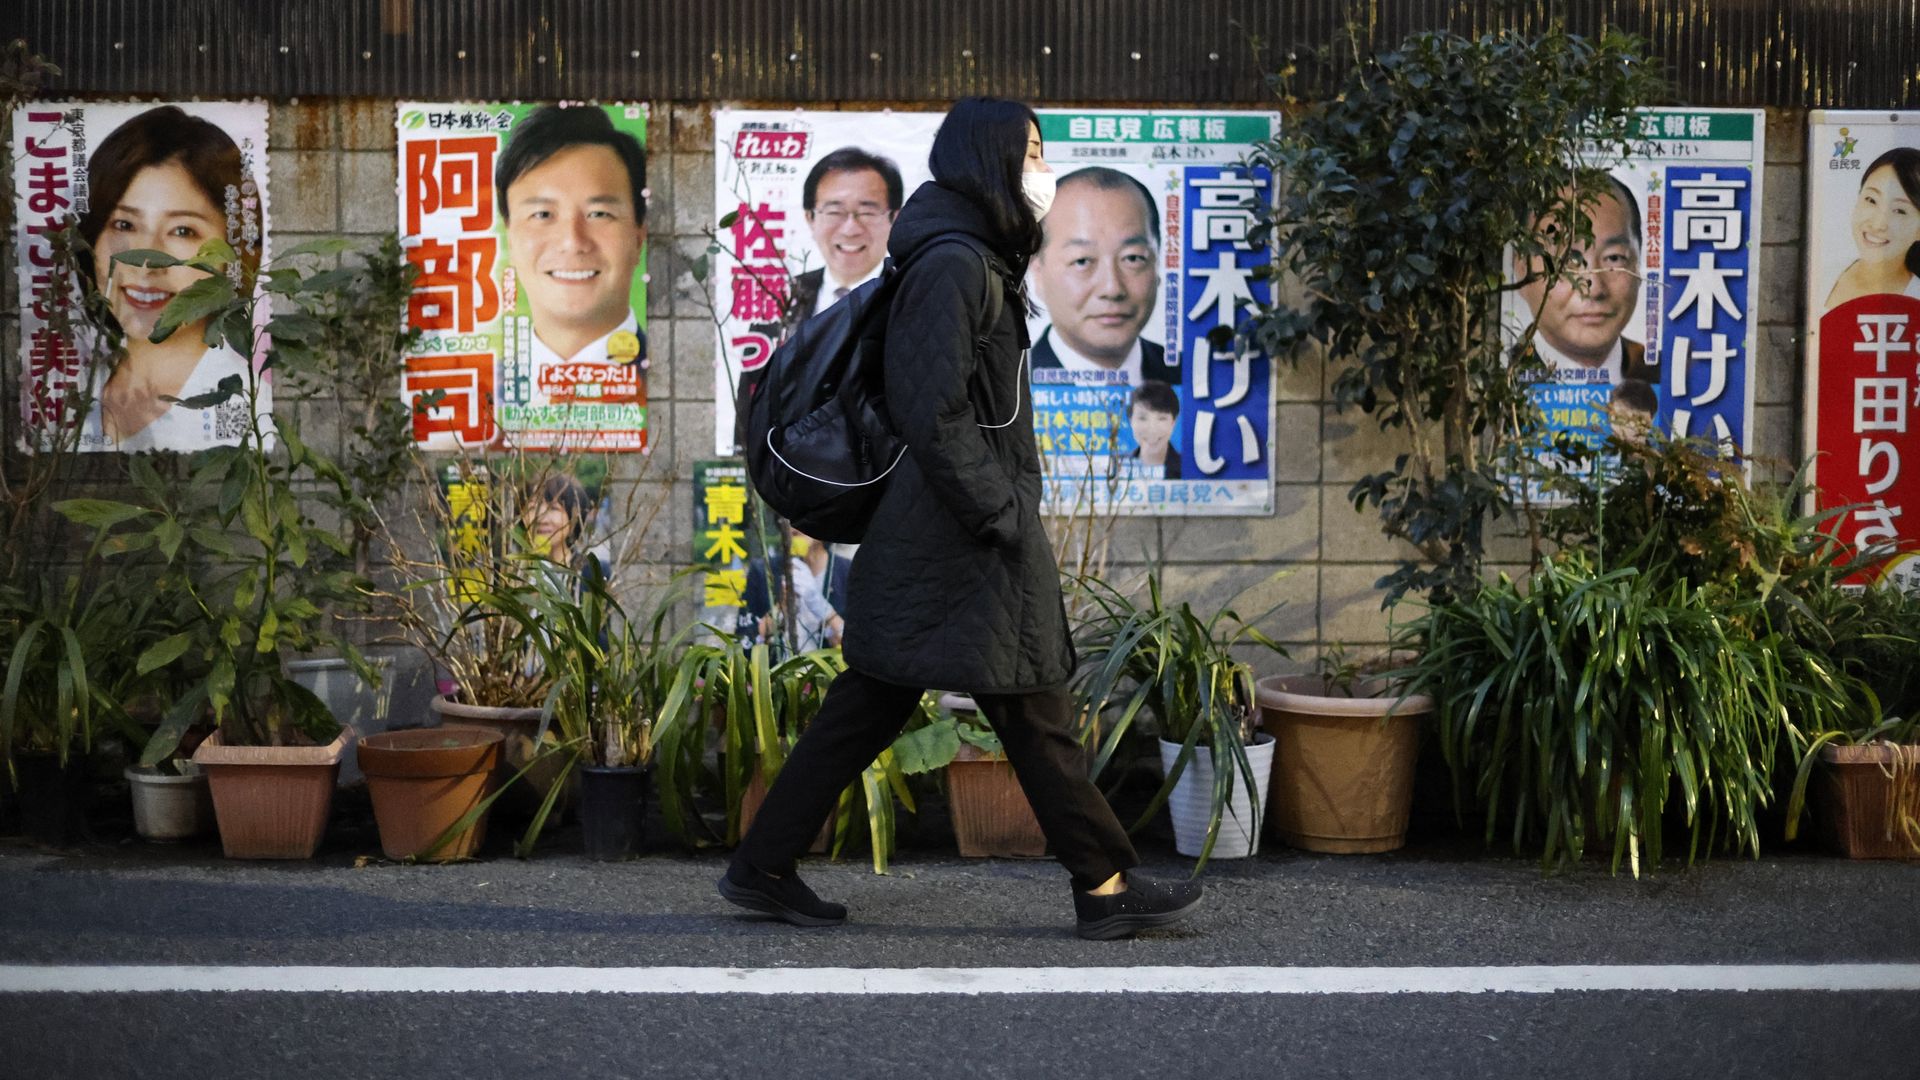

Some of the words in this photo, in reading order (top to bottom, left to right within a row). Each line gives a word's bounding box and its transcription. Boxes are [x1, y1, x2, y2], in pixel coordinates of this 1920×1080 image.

[1069, 117, 1142, 139] 自民党
[1152, 117, 1226, 140] 広報板
[1639, 115, 1711, 137] 広報板
[737, 133, 802, 157] れいわ
[1152, 145, 1181, 159] 高木
[1829, 159, 1861, 169] 自民党
[406, 136, 500, 445] 阿部司
[731, 201, 788, 394] 佐藤つ
[1187, 171, 1268, 475] 高木けい
[1668, 172, 1748, 457] 高木けい
[1527, 388, 1611, 404] しい時代へ！
[1853, 314, 1911, 555] 平田りさ
